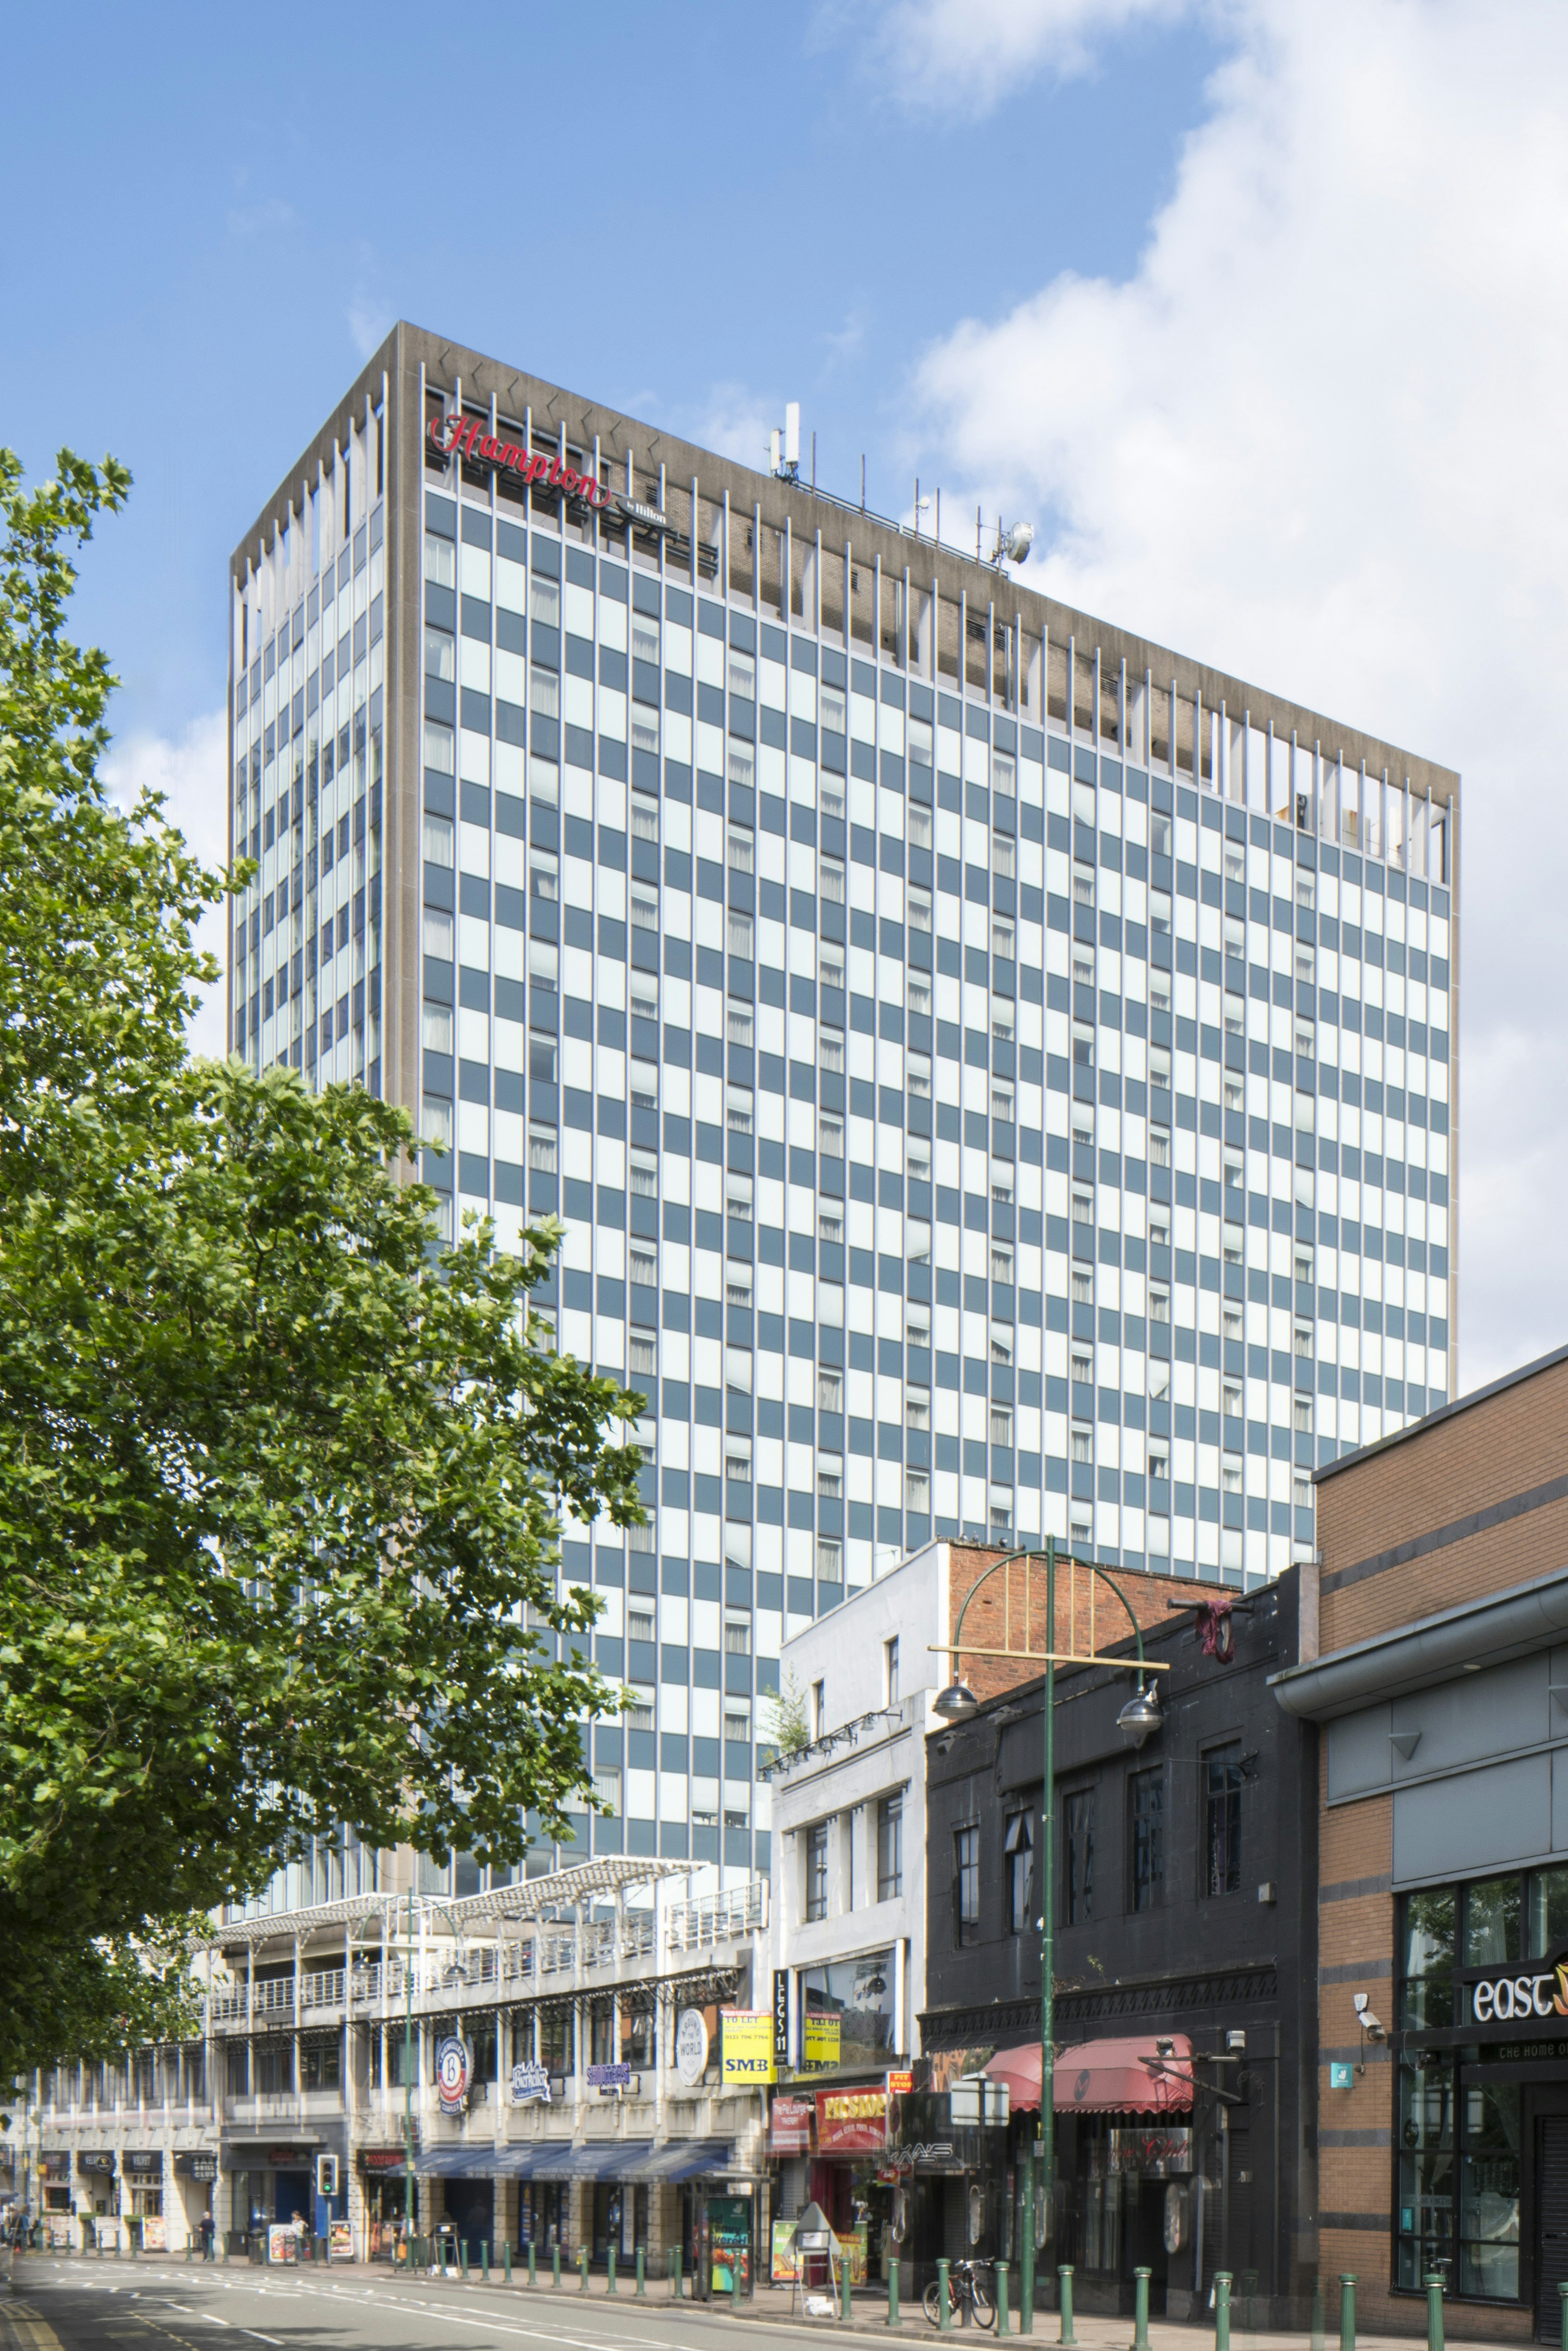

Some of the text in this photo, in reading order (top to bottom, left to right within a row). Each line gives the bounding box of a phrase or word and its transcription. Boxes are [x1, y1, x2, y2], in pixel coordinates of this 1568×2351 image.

[430, 415, 611, 507] Hampton
[627, 501, 666, 524] by Hilton
[777, 1973, 786, 2033] LEGS
[680, 2042, 701, 2056] WORLD
[776, 2036, 786, 2051] 11
[447, 2056, 456, 2082] B
[726, 2059, 768, 2072] SMB
[848, 2093, 888, 2118] STOP
